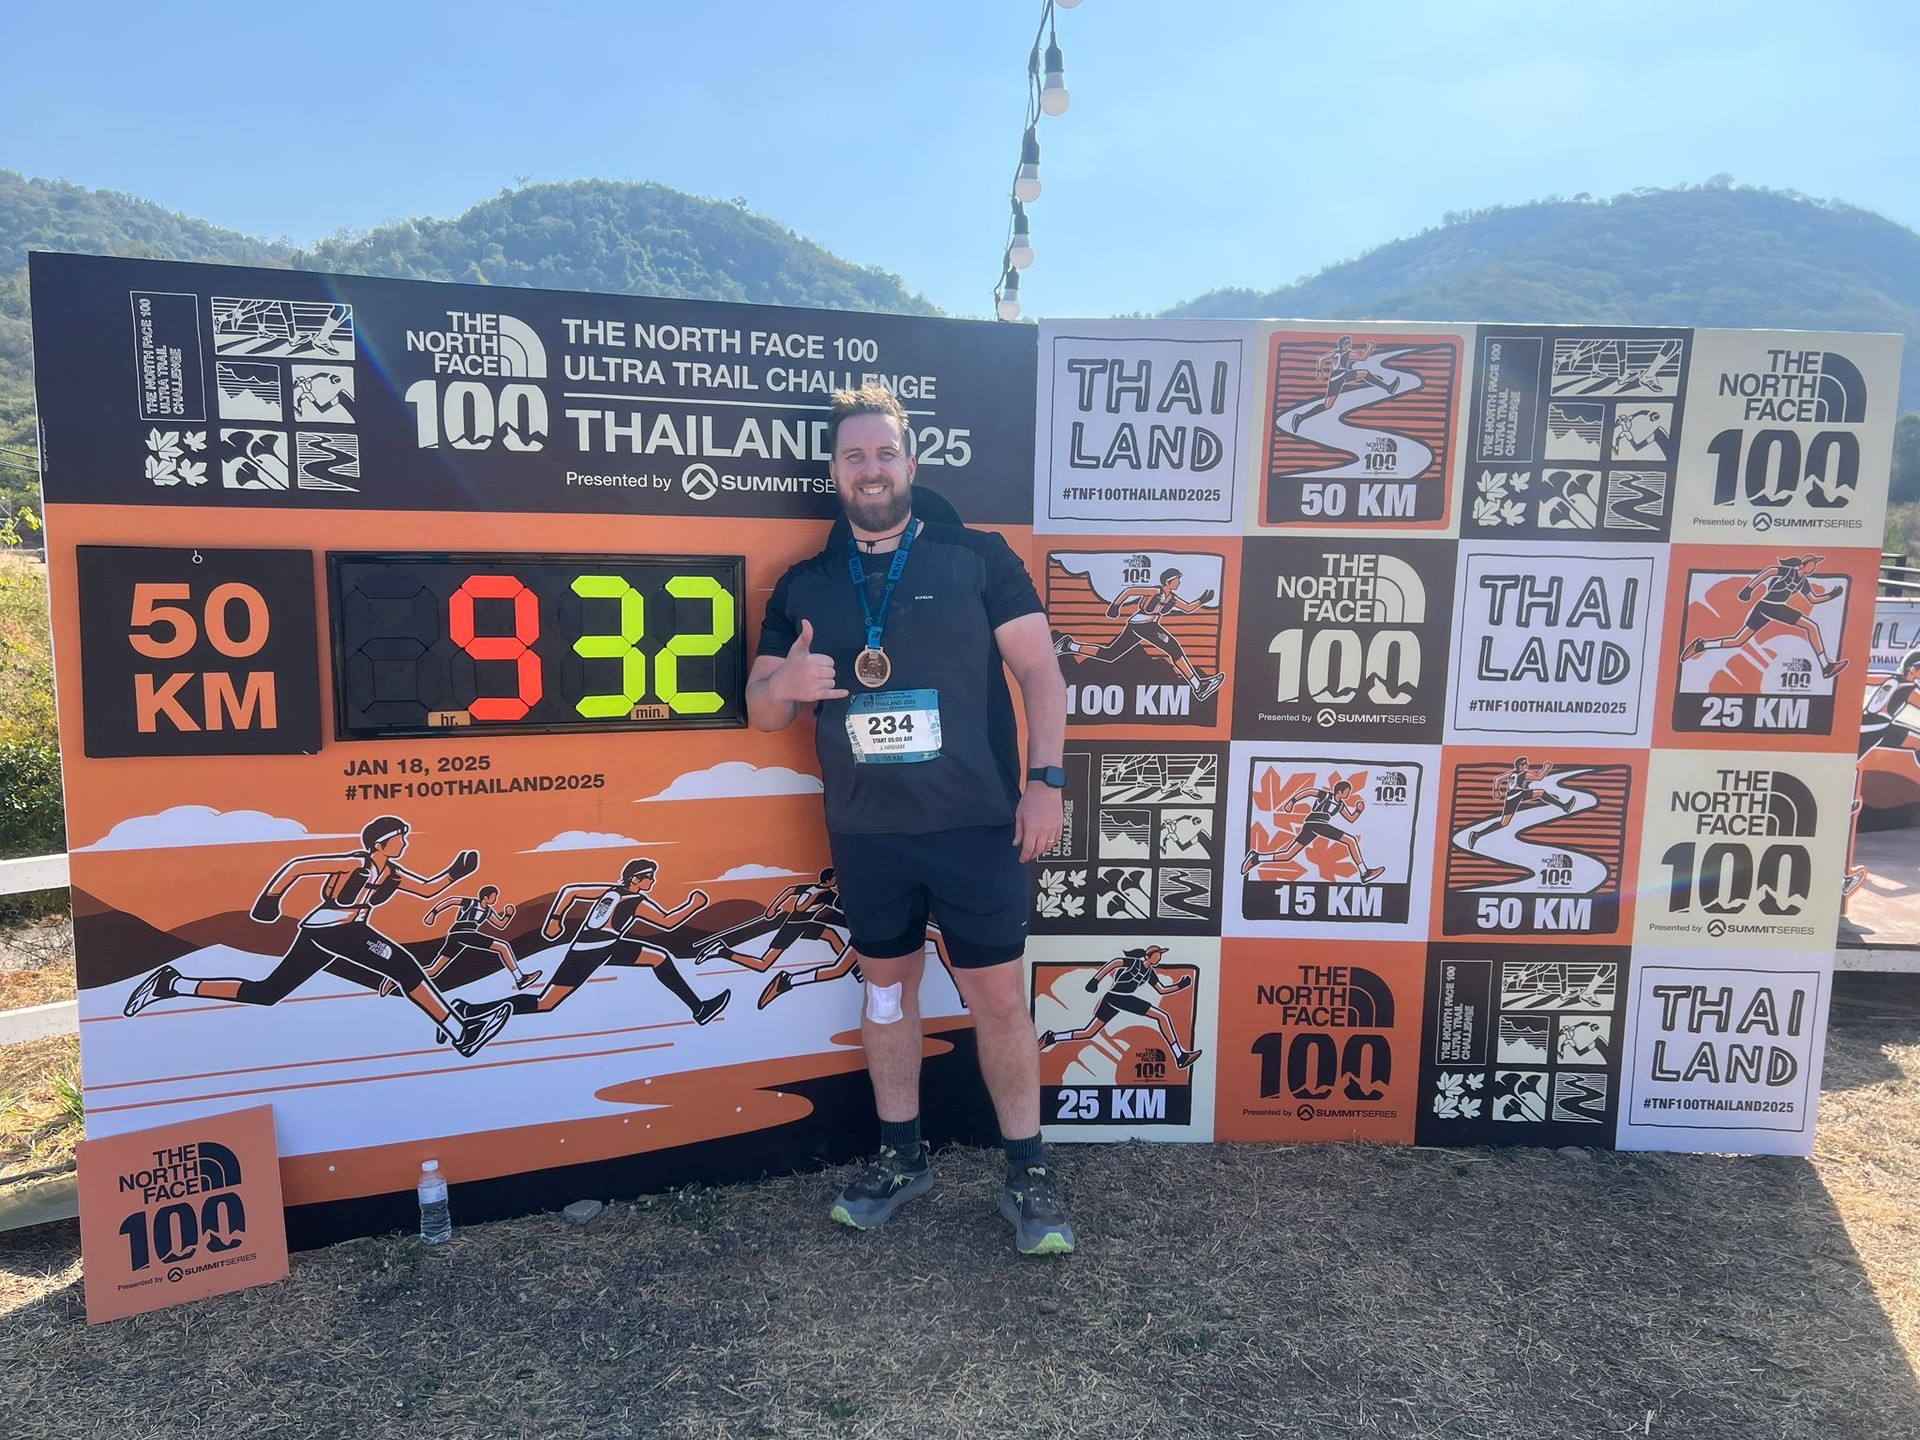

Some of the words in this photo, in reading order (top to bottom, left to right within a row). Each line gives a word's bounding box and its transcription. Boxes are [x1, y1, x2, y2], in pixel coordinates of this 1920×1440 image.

[139, 298, 151, 317] 100
[142, 320, 154, 348] FACE
[446, 311, 497, 334] THE
[406, 330, 498, 355] NORTH
[562, 318, 626, 347] THE
[635, 323, 741, 354] NORTH
[751, 331, 824, 360] FACE
[833, 338, 878, 363] 100
[1491, 344, 1501, 362] 100
[143, 350, 156, 390] NORTH
[156, 345, 168, 376] TRAIL
[435, 353, 498, 376] FACE
[564, 355, 666, 385] ULTRA
[673, 362, 759, 389] TRAIL
[1767, 350, 1820, 374] THE
[170, 348, 184, 415] CHALLENGE
[1068, 358, 1228, 415] THAI
[1488, 364, 1499, 392] FACE
[1719, 373, 1817, 398] NORTH
[145, 391, 158, 414] THE
[158, 378, 171, 414] ULTRA
[1497, 388, 1508, 420] TRAIL
[405, 380, 548, 451] 100
[1485, 394, 1497, 433] NORTH
[1744, 398, 1814, 422] FACE
[1505, 391, 1520, 456] CHALLENGE
[1070, 422, 1223, 472] LAND
[1483, 434, 1494, 456] THE
[1494, 421, 1506, 456] ULTRA
[1364, 454, 1396, 470] 100
[1707, 428, 1860, 508] 100
[566, 471, 647, 488] Presented
[653, 475, 672, 491] by
[1062, 487, 1221, 502] #TNF100THAILAND2025
[1301, 483, 1350, 517] 50
[1357, 483, 1417, 517] KM
[1693, 518, 1734, 526] Presented
[1737, 518, 1747, 527] by
[1774, 519, 1862, 528] SUMMITSERIES
[1123, 569, 1150, 583] 100
[1322, 554, 1376, 576] THE
[1277, 576, 1374, 599] NORTH
[1303, 600, 1372, 623] FACE
[1480, 575, 1638, 629] THAI
[128, 582, 270, 659] 50
[449, 575, 543, 721] 9
[570, 575, 734, 718] 32
[1478, 636, 1630, 685] LAND
[1268, 629, 1421, 704] 100
[1781, 673, 1810, 688] 100
[134, 671, 278, 733] KM
[636, 706, 664, 720] min.
[1135, 685, 1190, 716] KM
[1469, 700, 1626, 714] #TNF100THAILAND2025
[1700, 697, 1743, 728] 25
[1754, 697, 1810, 728] KM
[440, 713, 459, 726] hr.
[868, 714, 914, 735] 234
[1259, 713, 1299, 721] Presented
[1302, 714, 1312, 723] by
[1338, 714, 1426, 724] SUMMITSERIES
[343, 759, 388, 776] JAN
[397, 758, 430, 777] 18,
[438, 755, 491, 772] 2025
[345, 773, 605, 800] #TNF100THAILAND2025
[1717, 770, 1769, 792] THE
[1375, 787, 1406, 802] 100
[1671, 791, 1767, 814] NORTH
[1063, 800, 1073, 856] CHALLENGE
[1696, 814, 1765, 836] FACE
[1540, 869, 1572, 885] 100
[1661, 842, 1811, 915] 100
[1275, 884, 1316, 915] 15
[1328, 885, 1383, 917] KM
[1477, 898, 1522, 929] 50
[1533, 898, 1592, 930] KM
[1649, 923, 1690, 931] Presented
[1692, 924, 1702, 933] by
[1728, 925, 1814, 935] SUMMITSERIES
[1298, 965, 1348, 985] THE
[1446, 965, 1456, 981] 100
[1257, 985, 1347, 1006] NORTH
[1444, 983, 1454, 1006] FACE
[1282, 1006, 1345, 1027] FACE
[1453, 1003, 1463, 1029] TRAIL
[1653, 985, 1805, 1036] THAI
[1443, 1008, 1453, 1041] NORTH
[1461, 1006, 1474, 1060] CHALLENGE
[1441, 1041, 1451, 1060] THE
[1451, 1030, 1461, 1060] ULTRA
[1135, 1063, 1165, 1078] 100
[1251, 1032, 1392, 1100] 100
[1651, 1040, 1797, 1086] LAND
[1057, 1089, 1099, 1119] 25
[1111, 1088, 1166, 1119] KM
[1283, 1109, 1292, 1117] by
[1316, 1109, 1396, 1118] SUMMITSERIES
[1643, 1098, 1794, 1113] #TNF100THAILAND2025
[153, 1144, 196, 1166] THE
[119, 1160, 198, 1193] NORTH
[144, 1177, 199, 1205] FACE
[119, 1192, 245, 1271] 100
[118, 1278, 153, 1291] Presented
[155, 1276, 163, 1284] by
[185, 1253, 257, 1276] SUMMITSERIES
